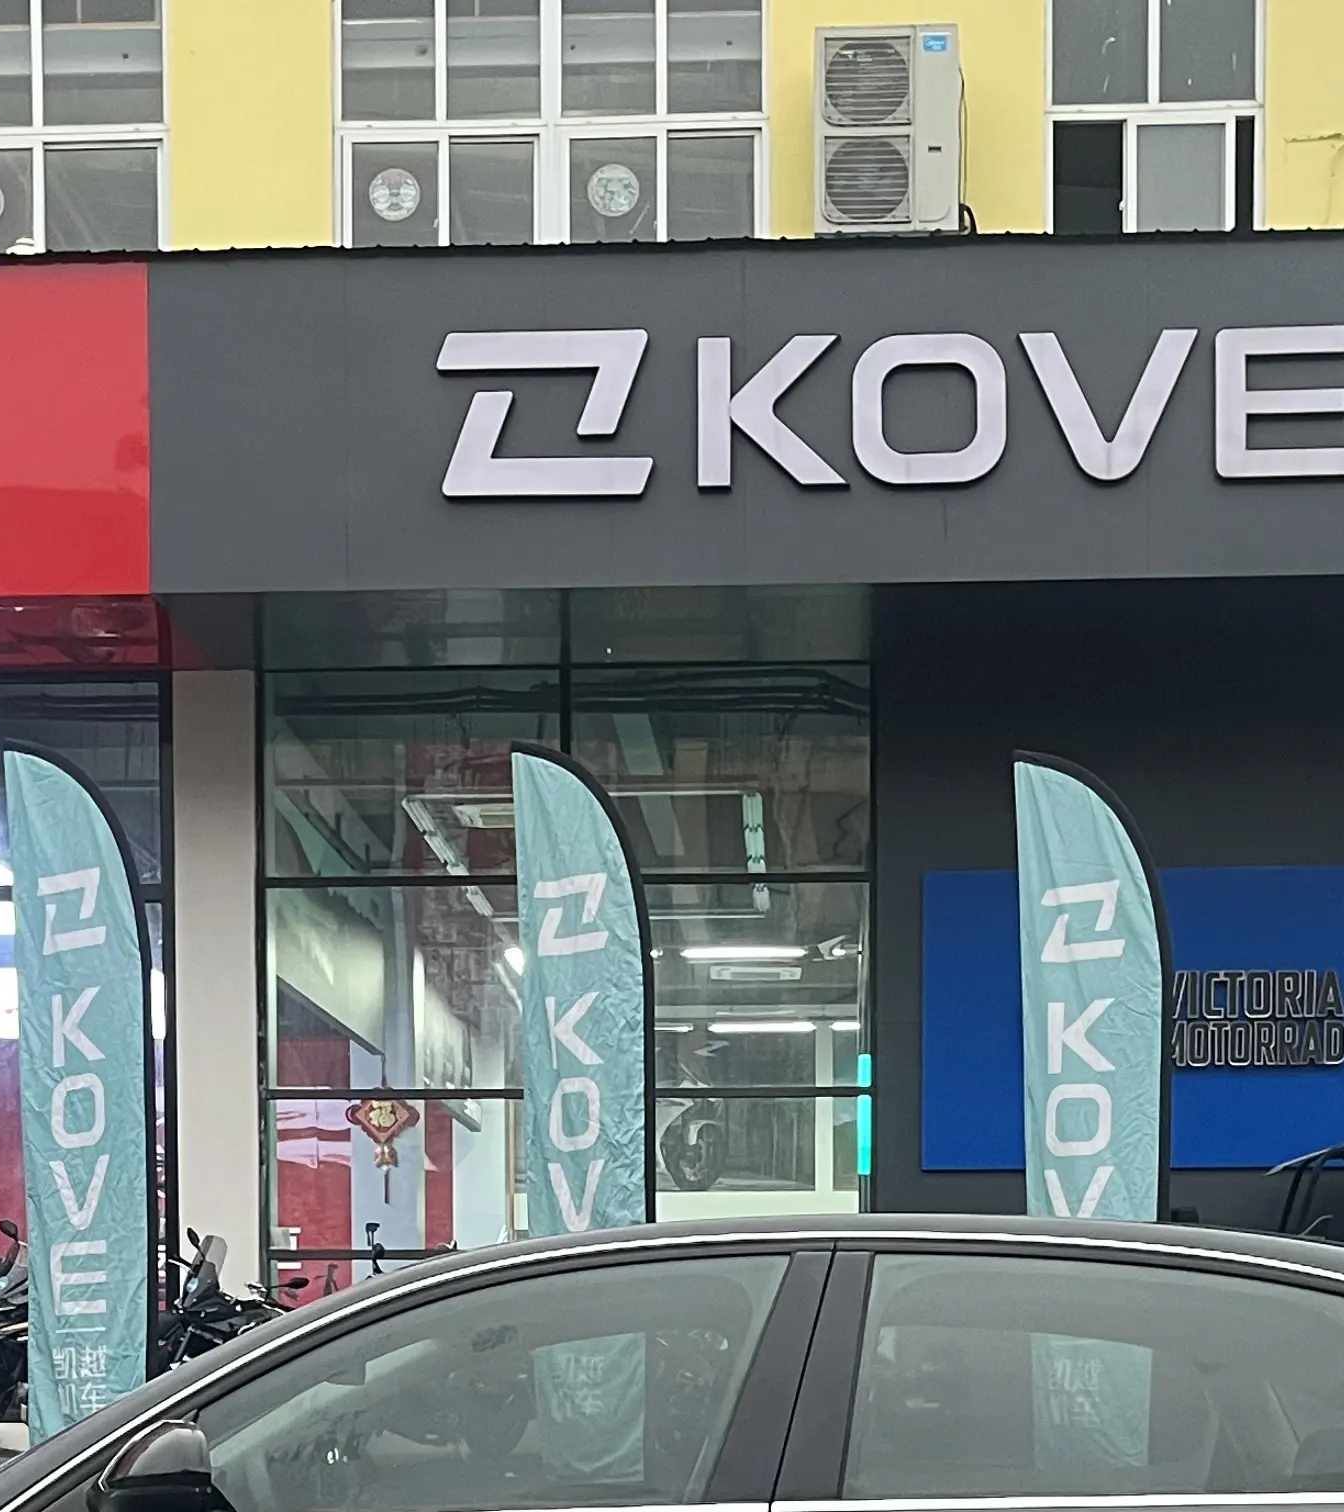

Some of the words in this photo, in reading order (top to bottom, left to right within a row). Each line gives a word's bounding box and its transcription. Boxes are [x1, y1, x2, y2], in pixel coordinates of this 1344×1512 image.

[49, 985, 111, 1316] KOVE
[546, 991, 605, 1232] KOV
[1044, 998, 1116, 1219] KOV
[54, 1345, 108, 1380] 凯越
